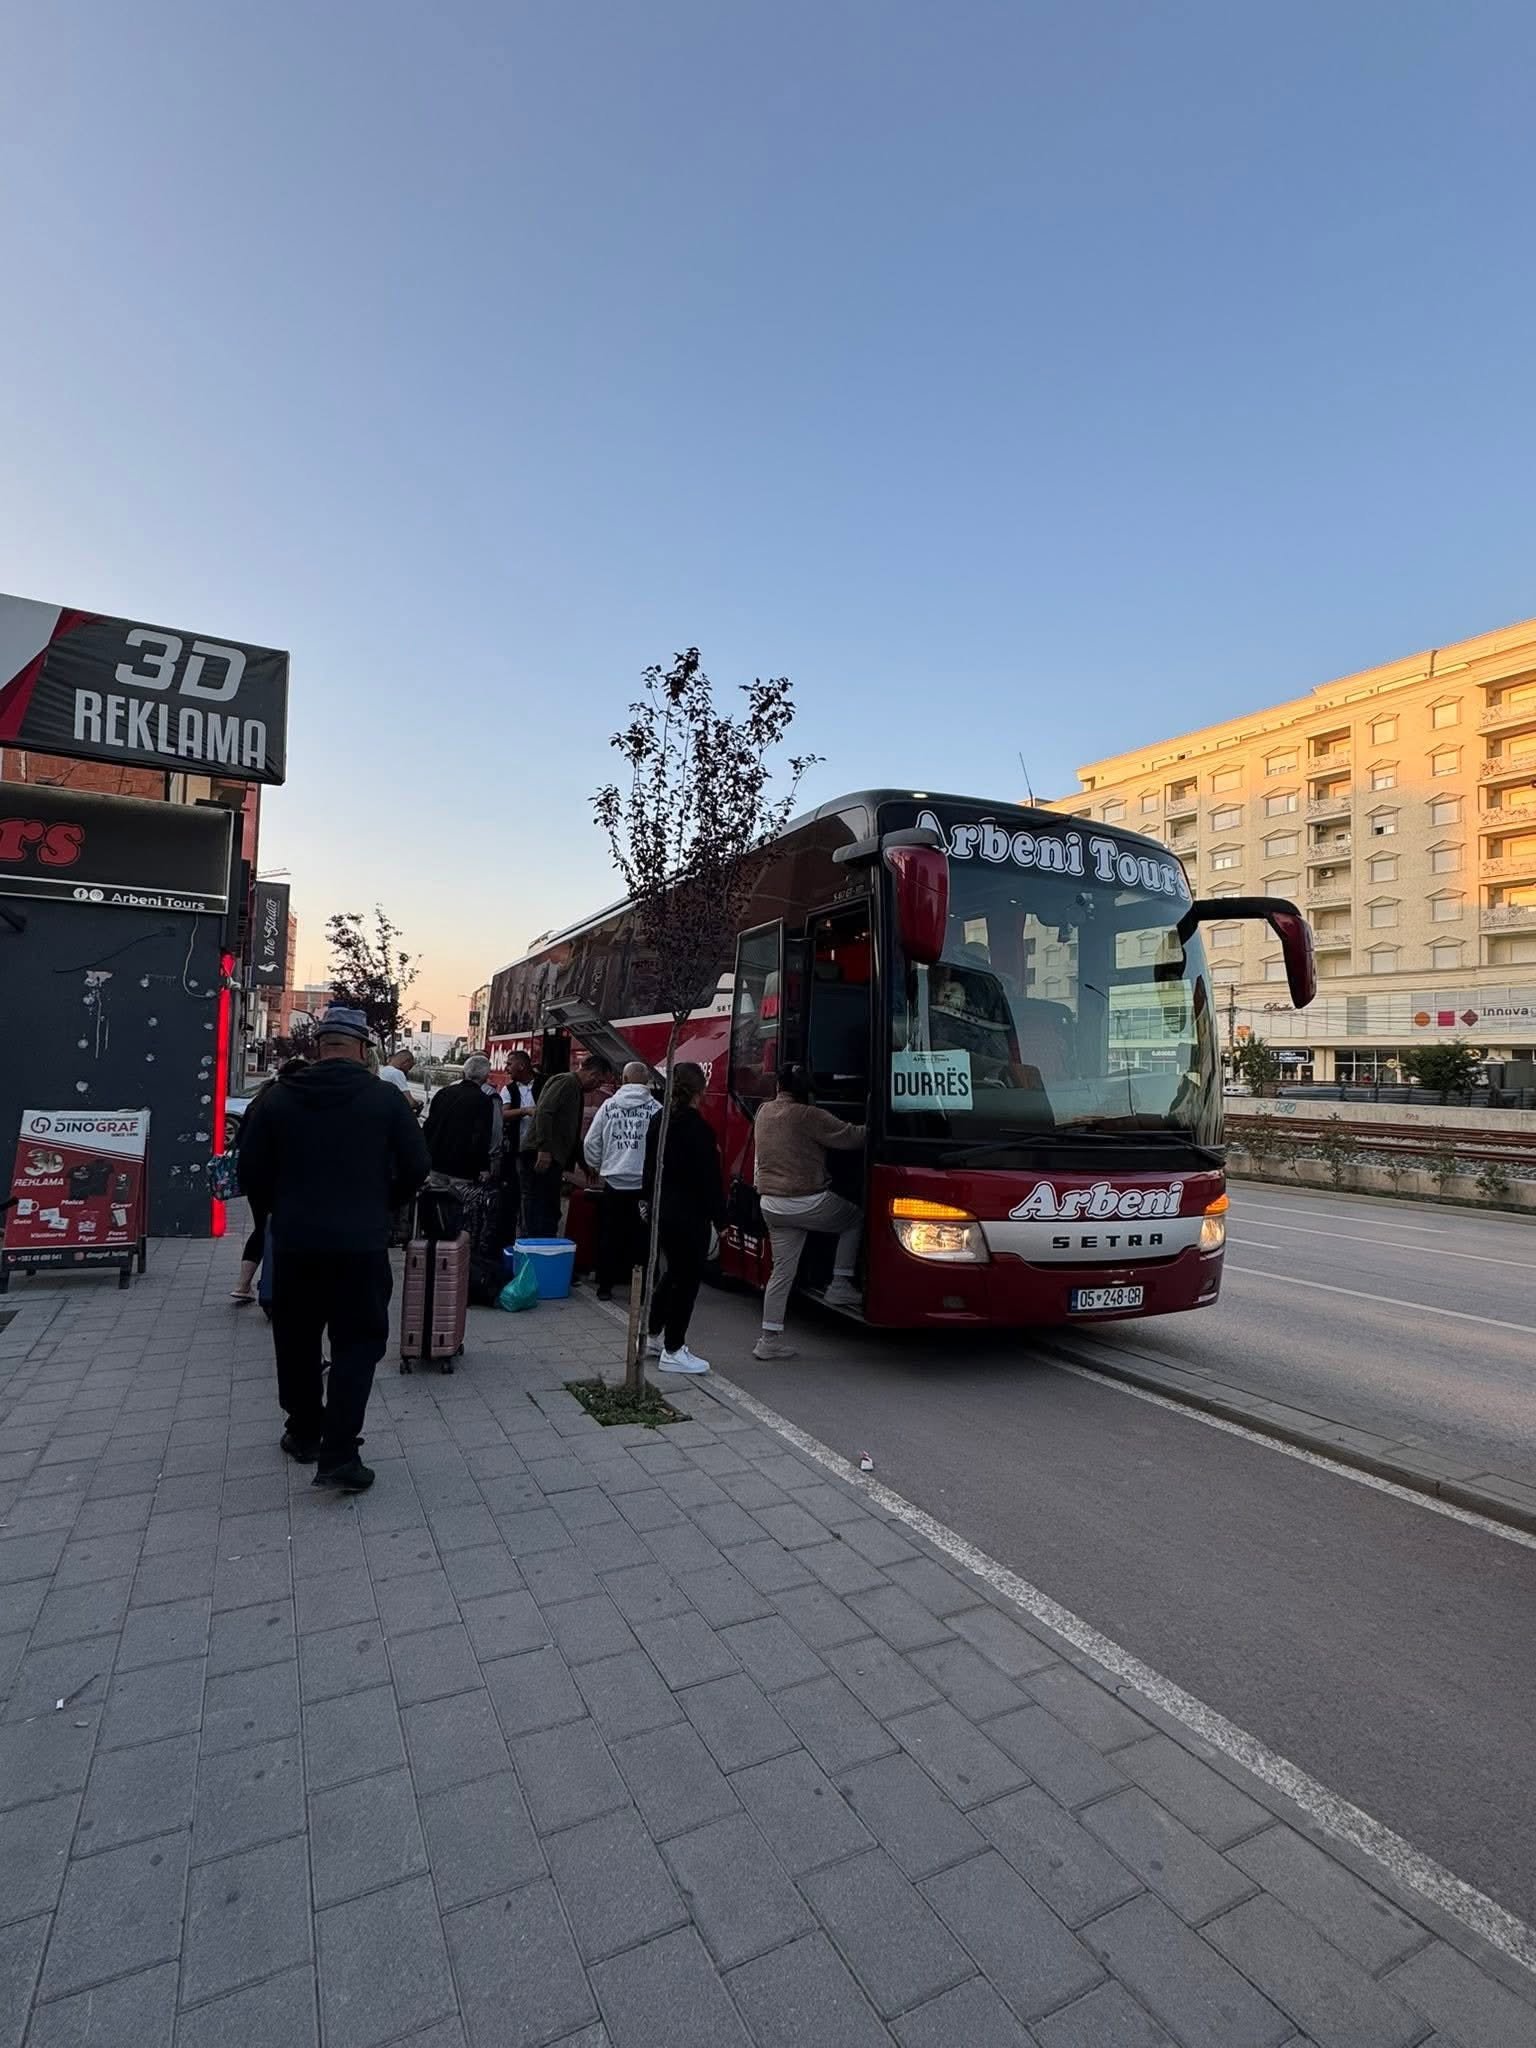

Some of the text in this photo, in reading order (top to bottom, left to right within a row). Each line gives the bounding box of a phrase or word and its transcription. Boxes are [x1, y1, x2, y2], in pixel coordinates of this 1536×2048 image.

[115, 628, 247, 702] 3D
[73, 688, 267, 770] REKLAMA
[915, 810, 1190, 902] Arbeni Tours
[112, 893, 206, 910] Arbeni Tours
[894, 1067, 969, 1097] DURRËS
[621, 1109, 645, 1118] Make
[54, 1122, 139, 1133] DINOGRAF
[612, 1131, 643, 1140] So Make
[617, 1141, 623, 1150] It
[23, 1148, 65, 1177] 3D
[13, 1177, 64, 1187] REKLAMA
[1009, 1180, 1184, 1221] Arbeni
[1052, 1233, 1163, 1249] SETRA
